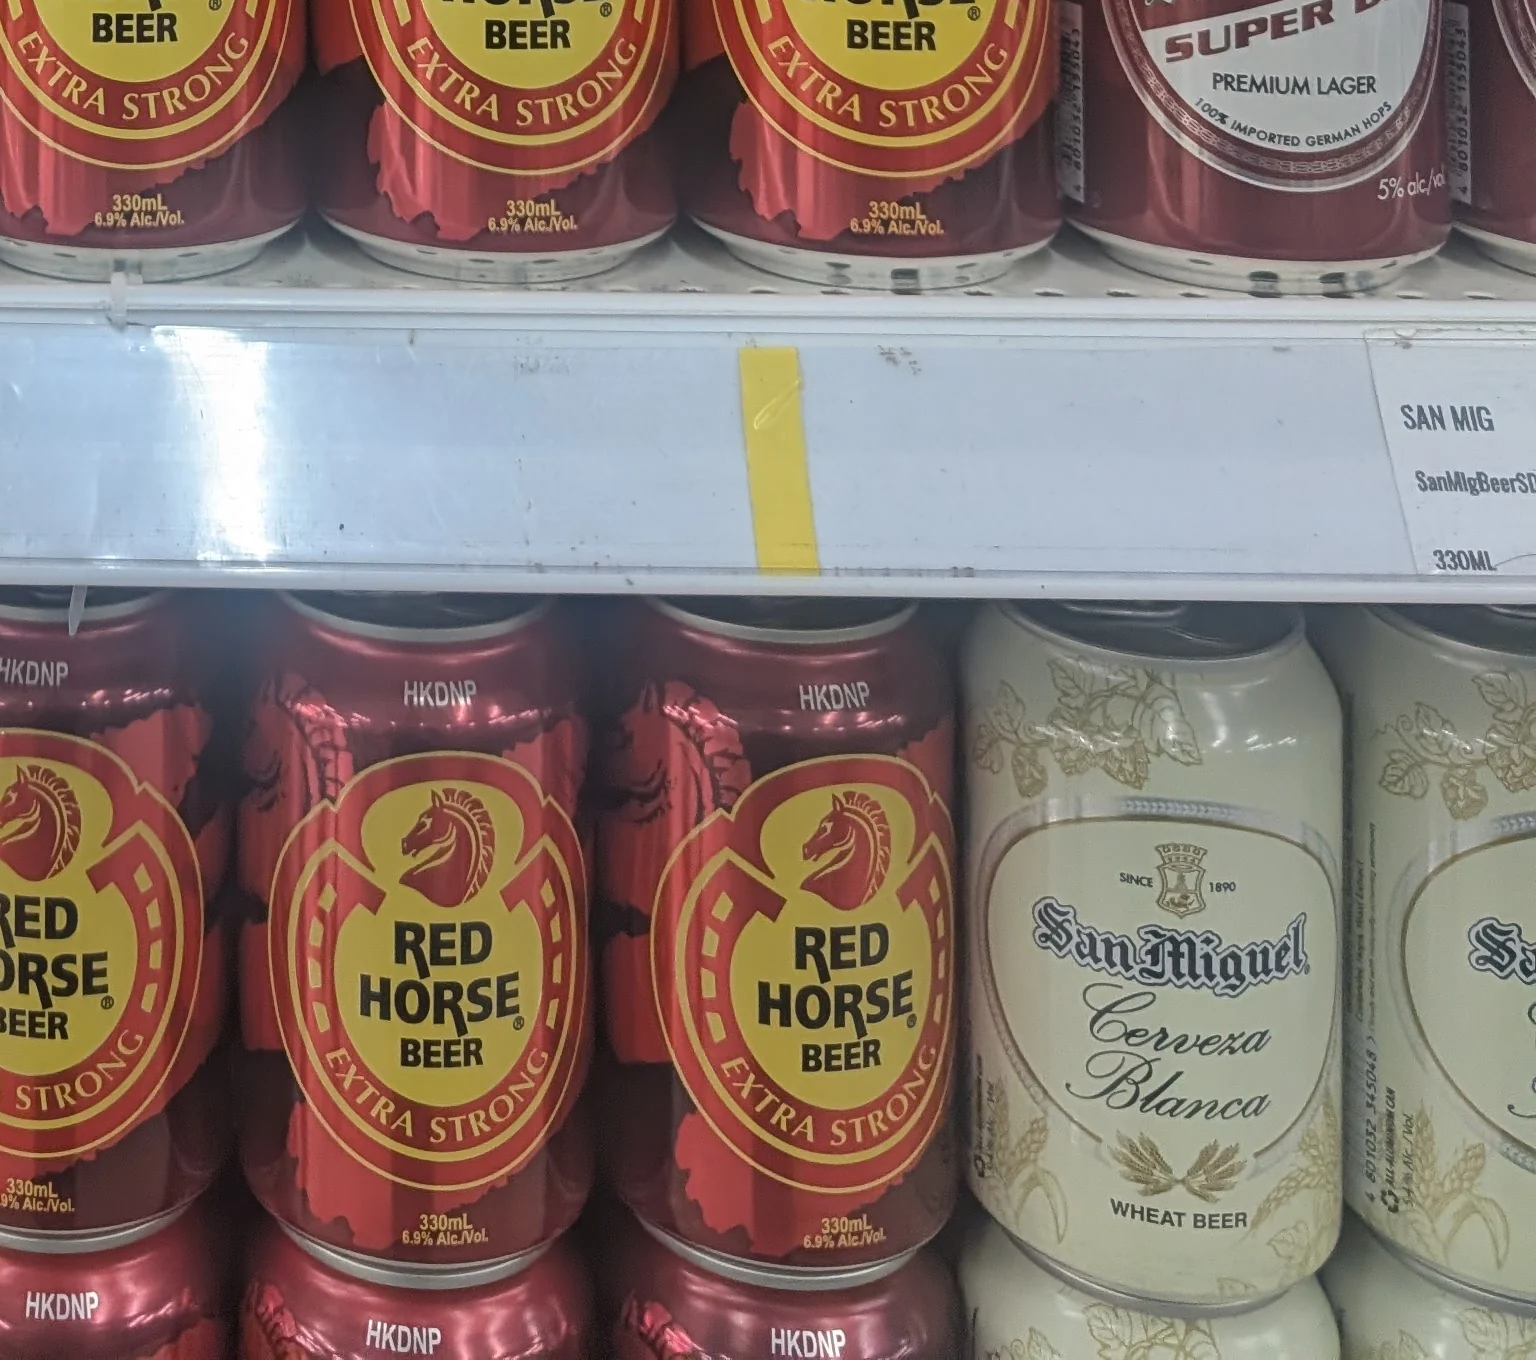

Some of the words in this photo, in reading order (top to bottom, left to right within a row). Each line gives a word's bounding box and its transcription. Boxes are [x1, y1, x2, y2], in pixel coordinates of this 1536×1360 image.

[846, 20, 937, 52] BEER
[1211, 72, 1311, 96] PREMIUM
[1316, 74, 1377, 96] LAGER
[1400, 404, 1446, 431] SAN
[1450, 405, 1495, 431] MIG
[1433, 549, 1497, 571] 330ML
[799, 681, 870, 711] HKDNP
[1118, 871, 1154, 888] SINCE
[1208, 879, 1237, 893] 1890
[795, 922, 890, 985] RED
[1032, 896, 1143, 969] San
[1140, 912, 1309, 996] Miguel
[758, 970, 914, 1041] HORSE
[1082, 981, 1272, 1056] Cerveza
[801, 1039, 882, 1073] BEER
[1065, 1049, 1272, 1121] Blanca
[1109, 1198, 1188, 1229] WHEAT
[1192, 1209, 1248, 1231] BEER
